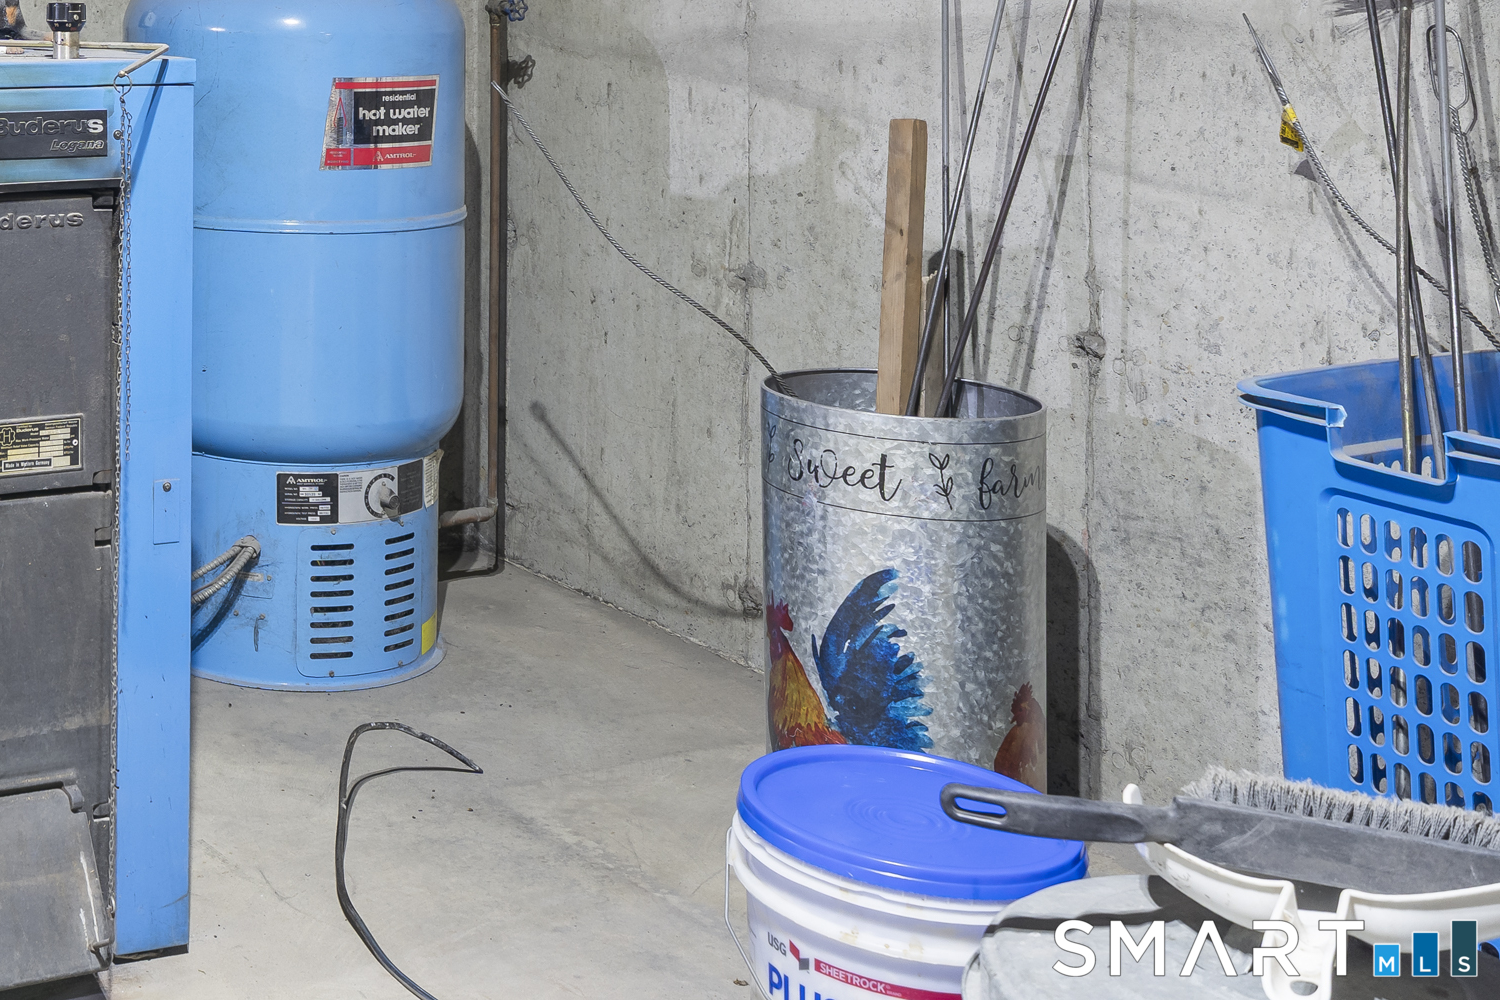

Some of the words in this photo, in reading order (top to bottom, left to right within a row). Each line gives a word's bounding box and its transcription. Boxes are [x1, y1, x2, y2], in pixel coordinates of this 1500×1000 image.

[382, 93, 417, 102] residential
[358, 106, 386, 120] hot
[389, 105, 431, 120] water
[372, 122, 421, 137] maker
[49, 138, 105, 153] Logana
[384, 152, 414, 160] AMTROL
[35, 459, 50, 467] Germany
[788, 438, 903, 502] Sweet
[767, 931, 788, 957] USG
[767, 961, 834, 1000] PL
[819, 962, 886, 994] SHEETROCK
